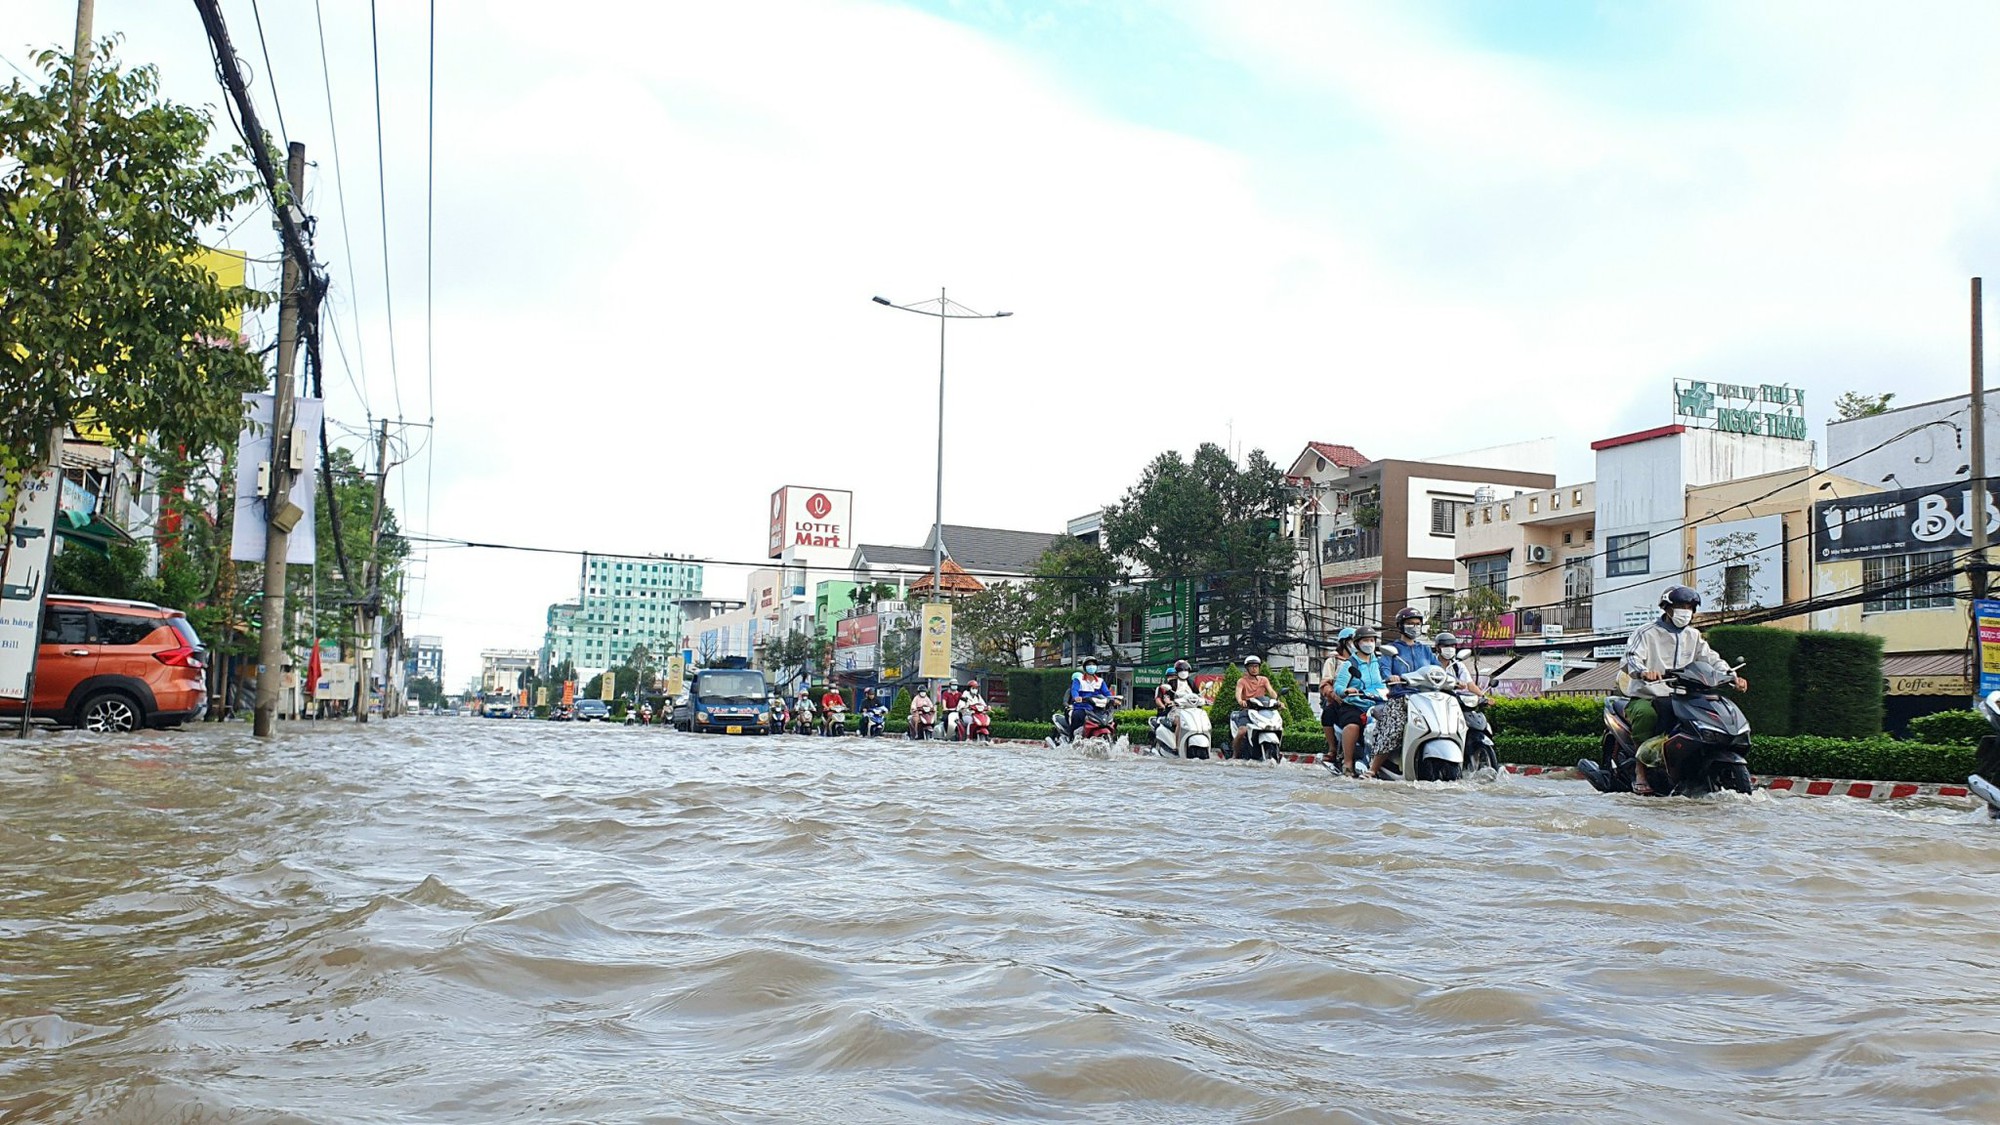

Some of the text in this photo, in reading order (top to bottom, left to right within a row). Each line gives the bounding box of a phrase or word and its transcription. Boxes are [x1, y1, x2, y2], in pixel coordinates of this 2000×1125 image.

[1760, 382, 1789, 404] THÚ
[1795, 389, 1805, 406] Y
[1717, 408, 1806, 440] NGỌC THẢO
[796, 522, 840, 534] LOTTE
[795, 532, 840, 547] Mart
[12, 617, 34, 629] hàng
[2, 640, 19, 649] Bill
[1897, 678, 1934, 692] Coffee
